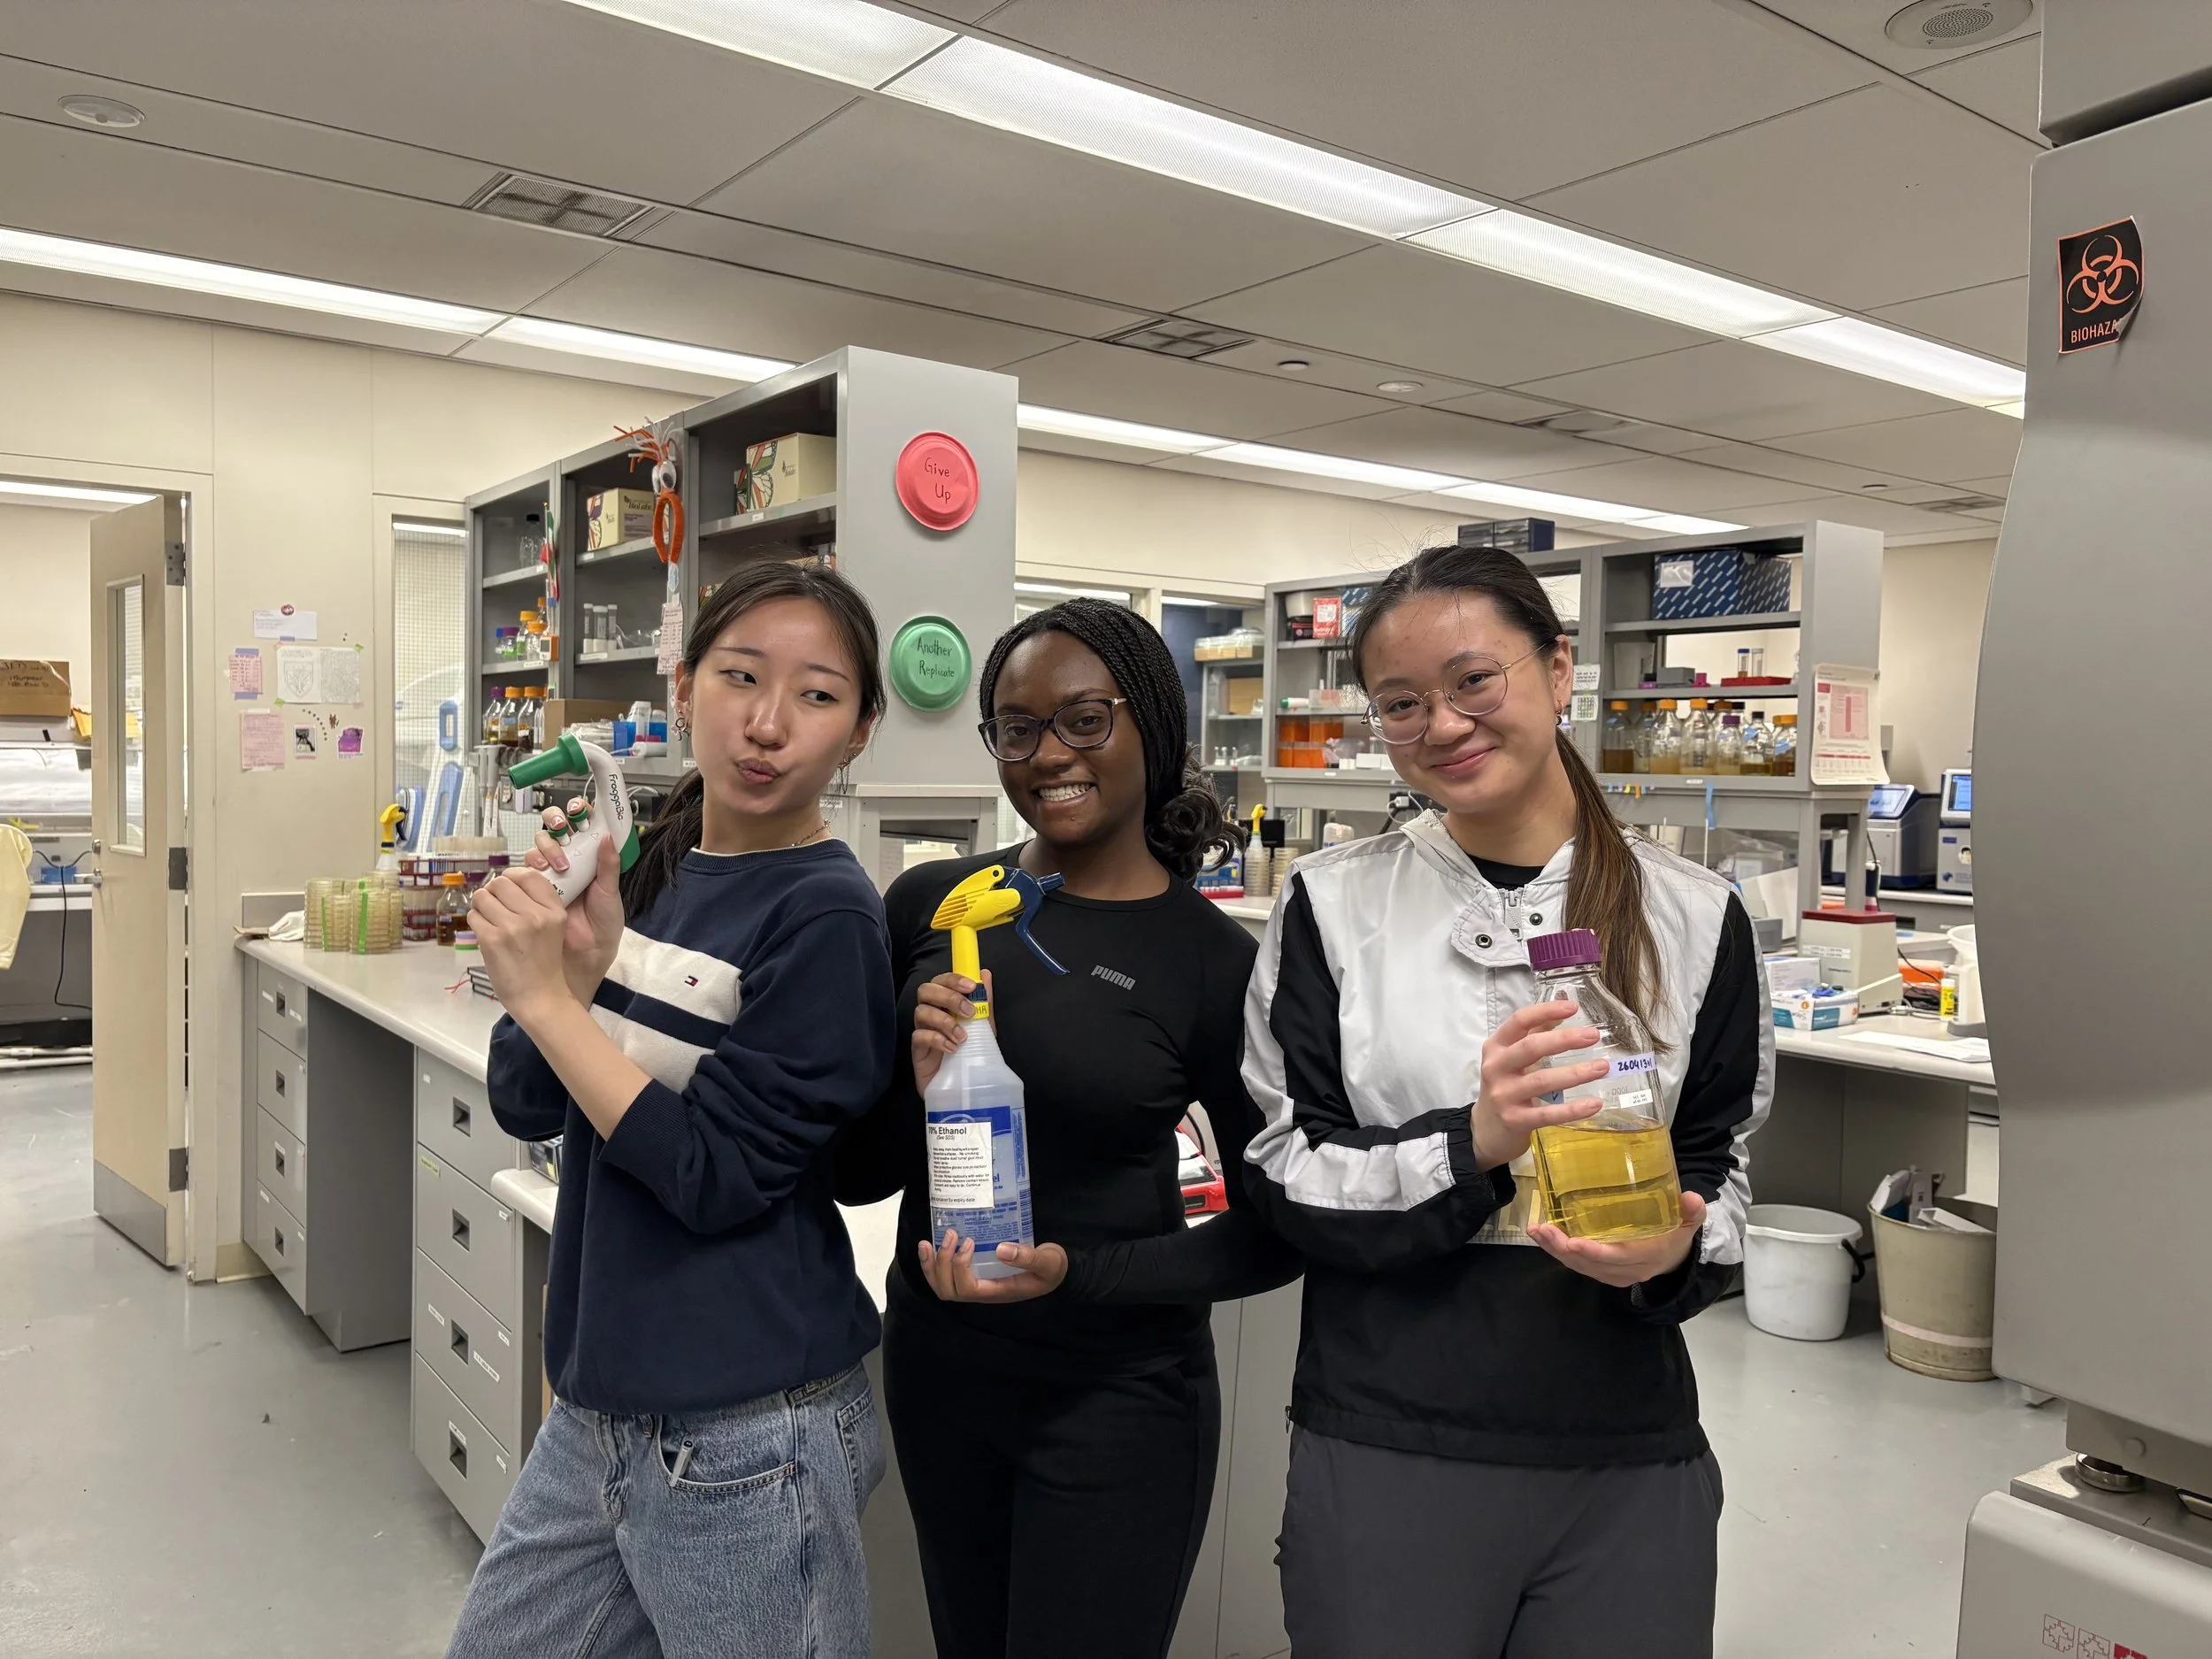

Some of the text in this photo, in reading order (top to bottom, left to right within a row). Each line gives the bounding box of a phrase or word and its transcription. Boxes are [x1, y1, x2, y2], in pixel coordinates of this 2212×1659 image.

[2070, 319, 2119, 343] BIOHAZA
[925, 457, 950, 478] Give
[934, 483, 951, 504] Up
[917, 636, 953, 657] Another
[919, 659, 955, 678] Replicate
[1090, 964, 1136, 991] PUMA
[938, 1126, 967, 1135] Ethanol
